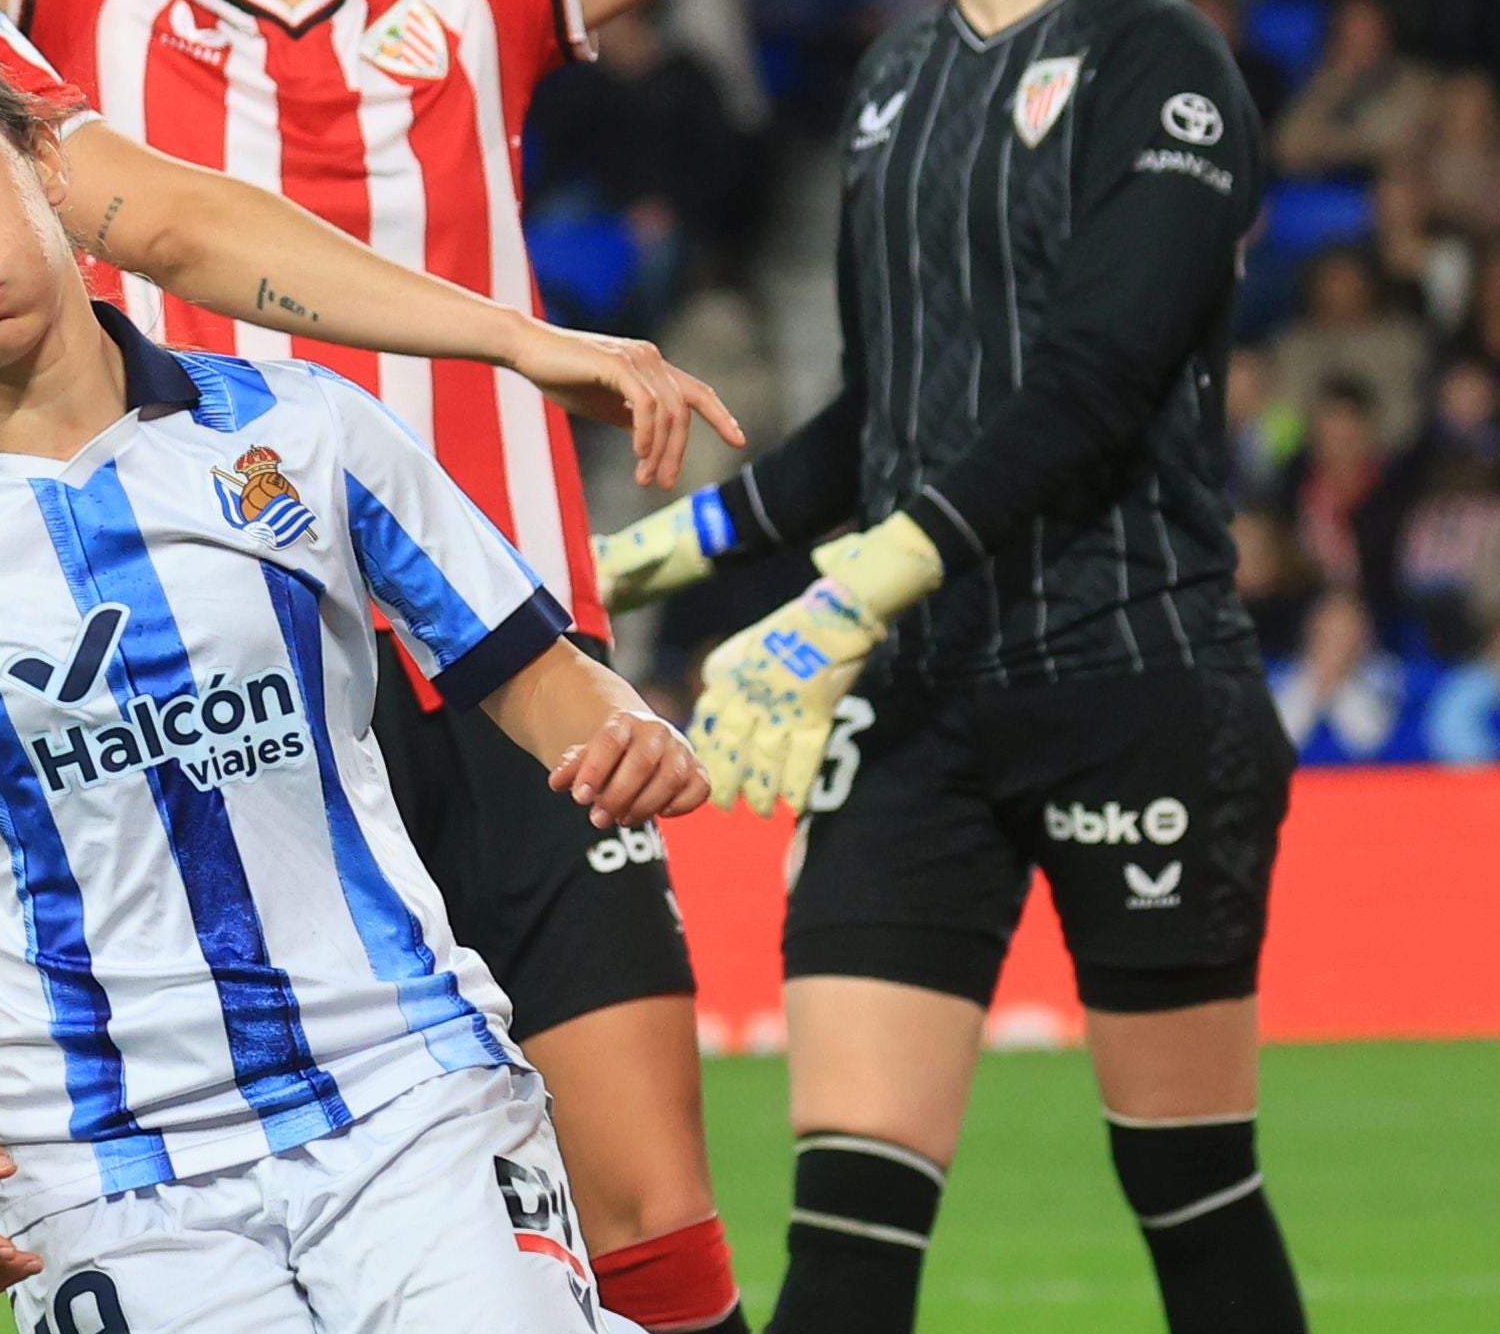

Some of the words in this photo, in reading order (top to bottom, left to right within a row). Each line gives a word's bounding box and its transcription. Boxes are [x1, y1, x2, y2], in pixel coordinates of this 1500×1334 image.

[31, 672, 296, 792] Halcón
[186, 731, 305, 785] viajes
[1043, 800, 1142, 845] bbk
